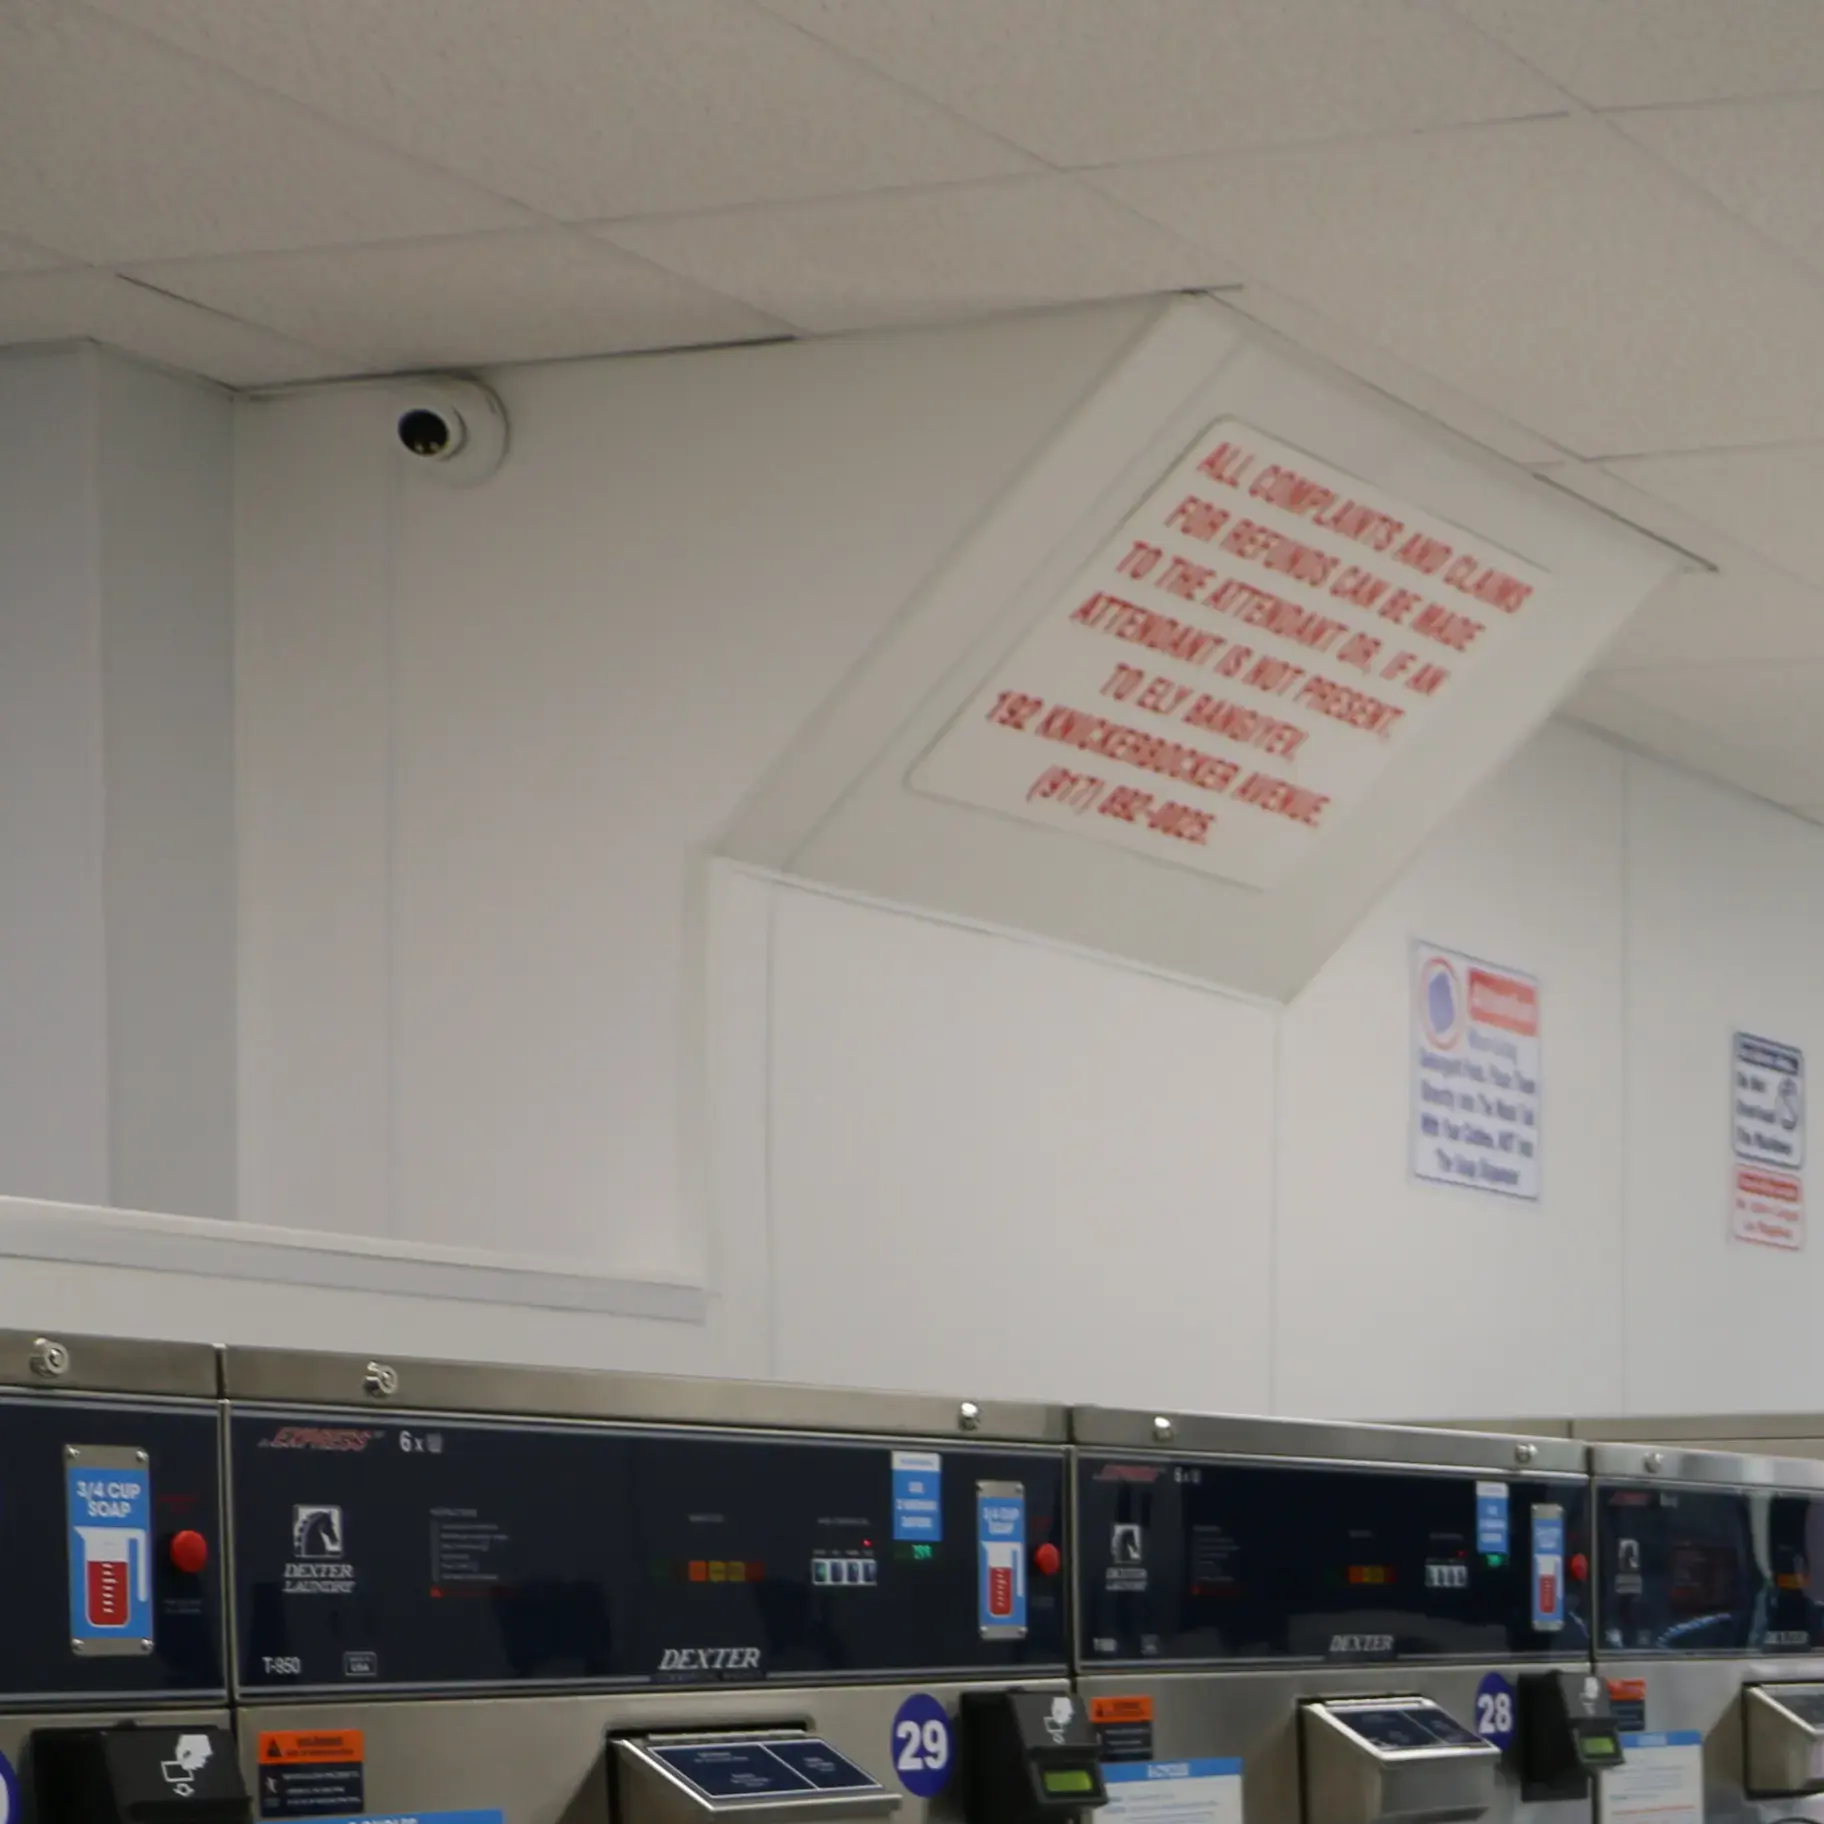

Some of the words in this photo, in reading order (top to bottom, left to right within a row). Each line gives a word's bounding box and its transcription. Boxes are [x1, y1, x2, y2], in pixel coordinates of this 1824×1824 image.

[1198, 441, 1251, 489] ALL
[1248, 465, 1406, 552] COMPLAINTS
[1391, 533, 1454, 576] AND
[1441, 556, 1535, 614] CLAIMS
[1167, 494, 1232, 541] FOR
[1218, 517, 1342, 589] REFUNDS
[1327, 566, 1391, 610] CAN
[1377, 588, 1424, 626] BE
[1412, 604, 1483, 650] MADE
[1116, 539, 1165, 581] TO
[1155, 555, 1217, 601] THE
[1204, 579, 1350, 651] ATTENDANT
[1381, 653, 1418, 679] IF
[1405, 663, 1447, 695] AN
[1070, 592, 1225, 666] ATTENDANT
[1214, 644, 1254, 678] IS
[1239, 657, 1306, 693] NOT
[1101, 662, 1147, 703] TO
[1034, 705, 1241, 793] KNICKERBOCKER
[1233, 773, 1331, 827] AVENUE
[400, 1430, 411, 1452] 6
[76, 1481, 104, 1499] 3/4
[107, 1483, 141, 1499] CUP
[87, 1500, 131, 1518] SOAP
[283, 1563, 355, 1578] DEXTER
[658, 1647, 761, 1670] DEXTER
[1329, 1635, 1394, 1651] DEXTER
[1477, 1693, 1512, 1733] 28
[898, 1720, 948, 1770] 29
